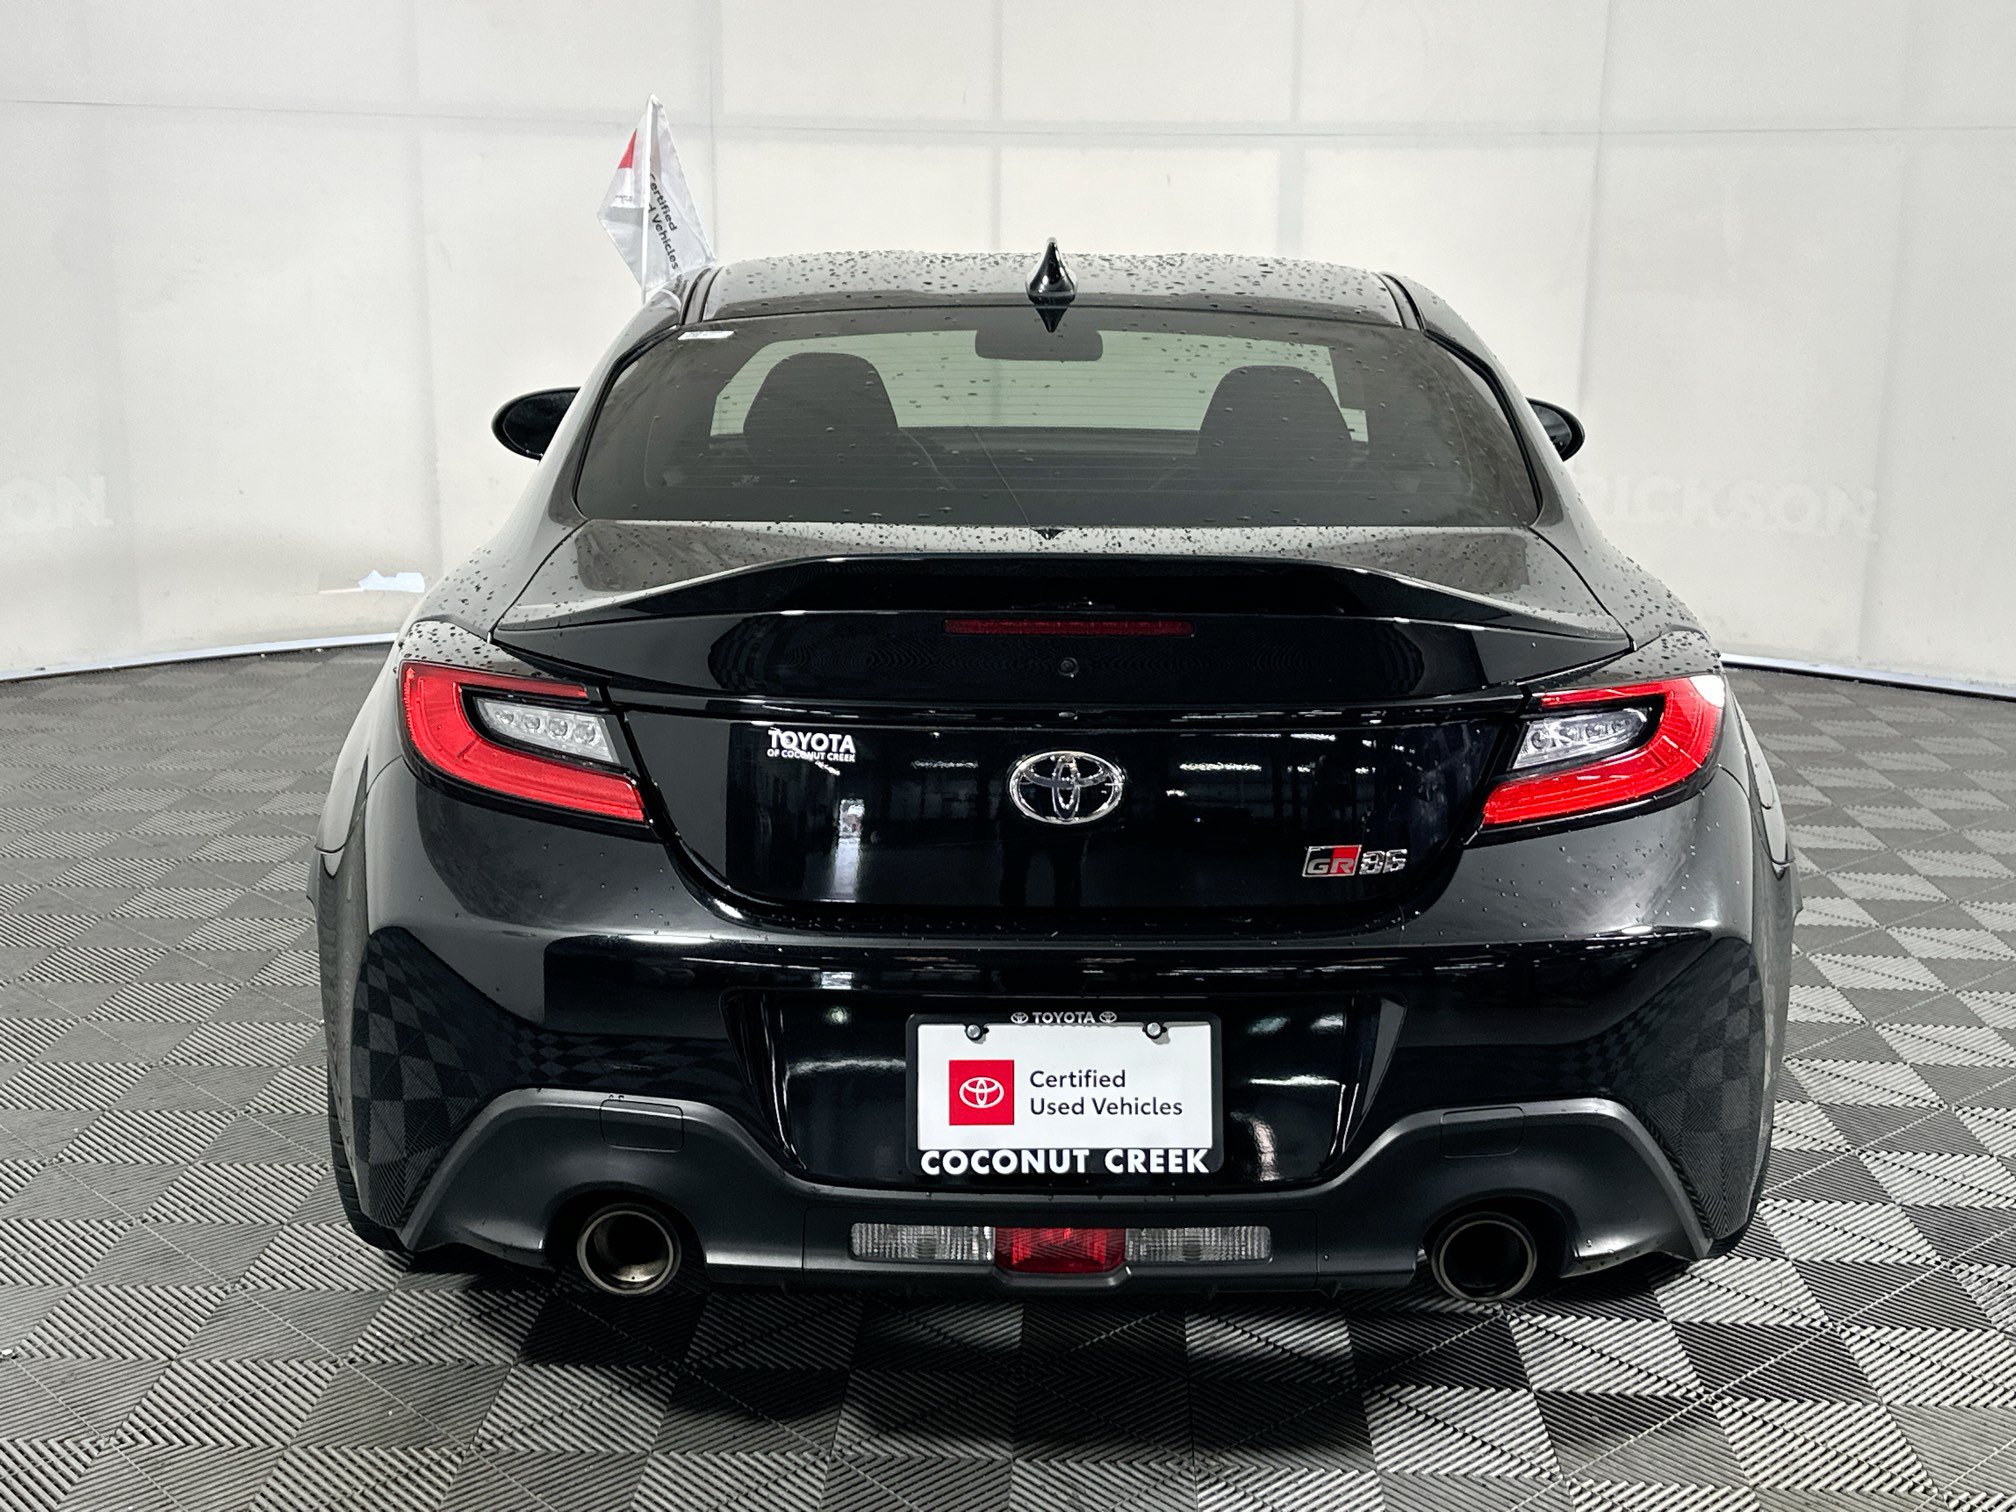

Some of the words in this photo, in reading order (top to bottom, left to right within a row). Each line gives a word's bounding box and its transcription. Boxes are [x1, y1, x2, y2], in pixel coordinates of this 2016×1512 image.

[652, 213, 679, 270] Vehicles
[768, 730, 856, 753] TOYOTA
[767, 749, 780, 757] OF
[781, 750, 826, 760] COCONUT
[827, 752, 856, 762] CREEK
[1032, 1011, 1096, 1024] TOYOTA
[1030, 1069, 1126, 1088] Certified
[1030, 1097, 1085, 1115] Used
[1091, 1097, 1183, 1115] Vehicles
[920, 1149, 1089, 1176] COCONUT
[1104, 1148, 1210, 1174] CREEK
